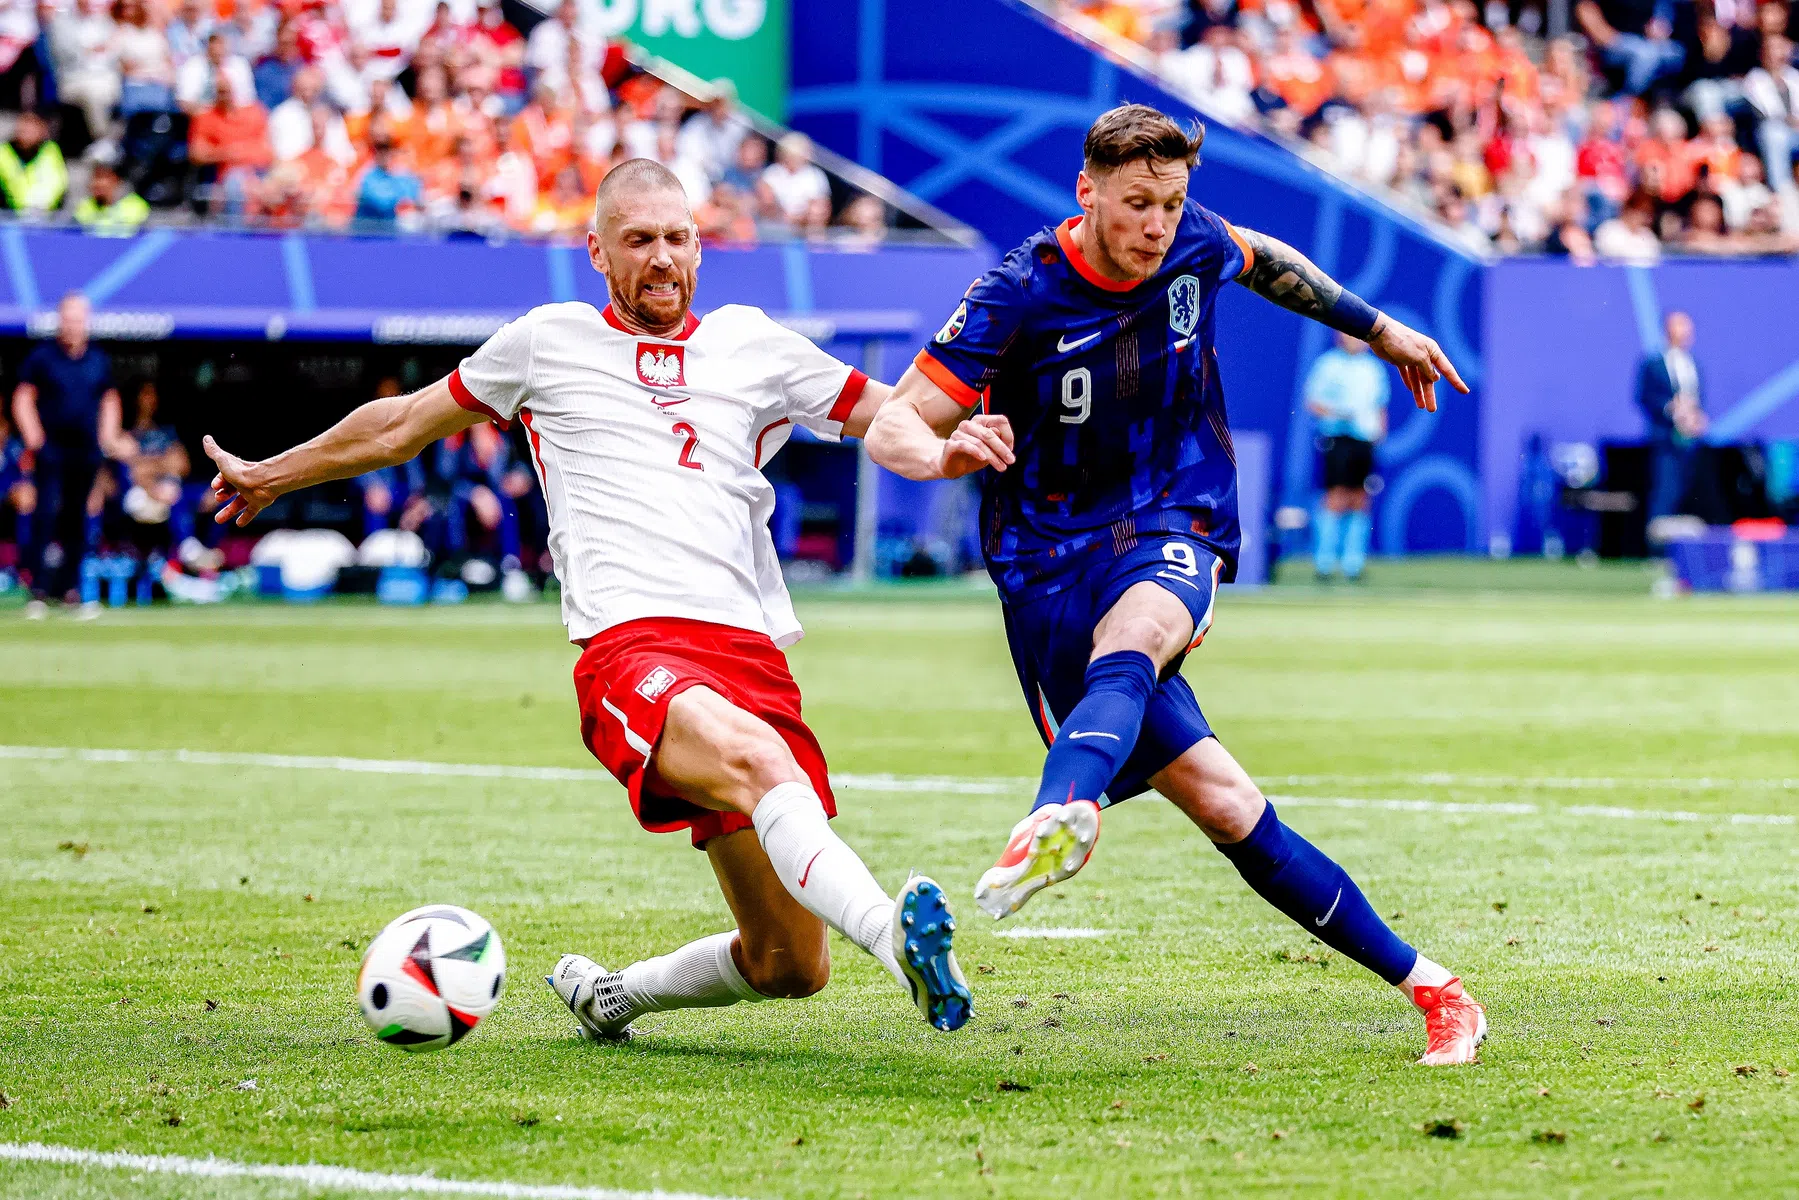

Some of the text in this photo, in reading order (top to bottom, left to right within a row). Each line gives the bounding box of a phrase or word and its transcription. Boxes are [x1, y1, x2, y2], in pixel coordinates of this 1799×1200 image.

[1060, 366, 1092, 424] 9
[672, 421, 704, 472] 2
[1161, 541, 1199, 577] 9
